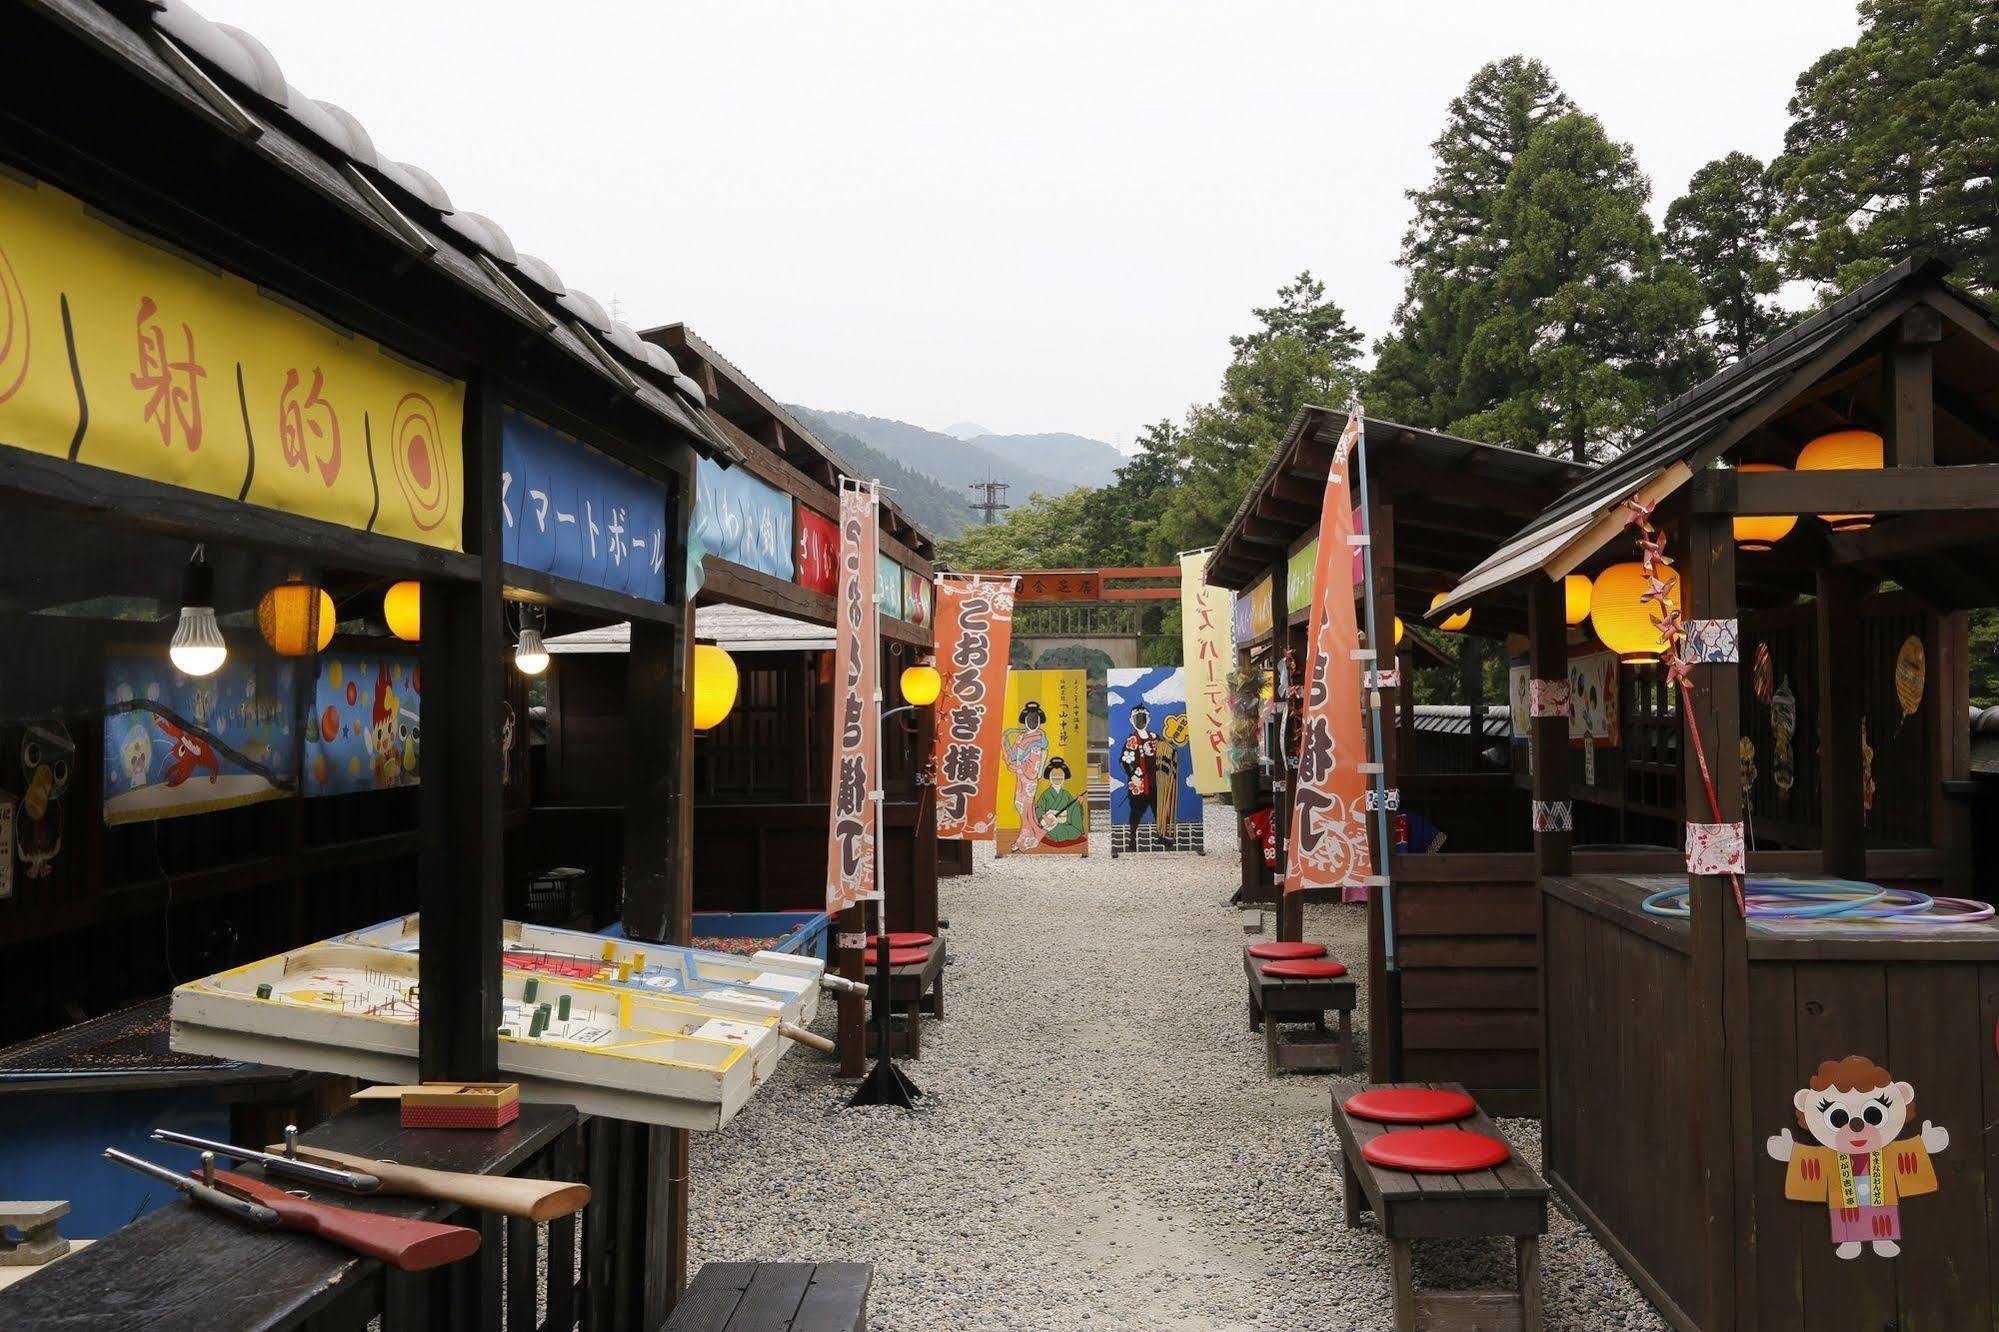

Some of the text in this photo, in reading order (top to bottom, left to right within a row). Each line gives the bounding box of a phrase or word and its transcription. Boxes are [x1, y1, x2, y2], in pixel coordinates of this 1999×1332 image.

[129, 296, 342, 488] 射的
[502, 471, 665, 576] スマートボール
[939, 597, 991, 821] こおろぎ横丁
[1871, 1151, 1882, 1205] やまなかおんせん
